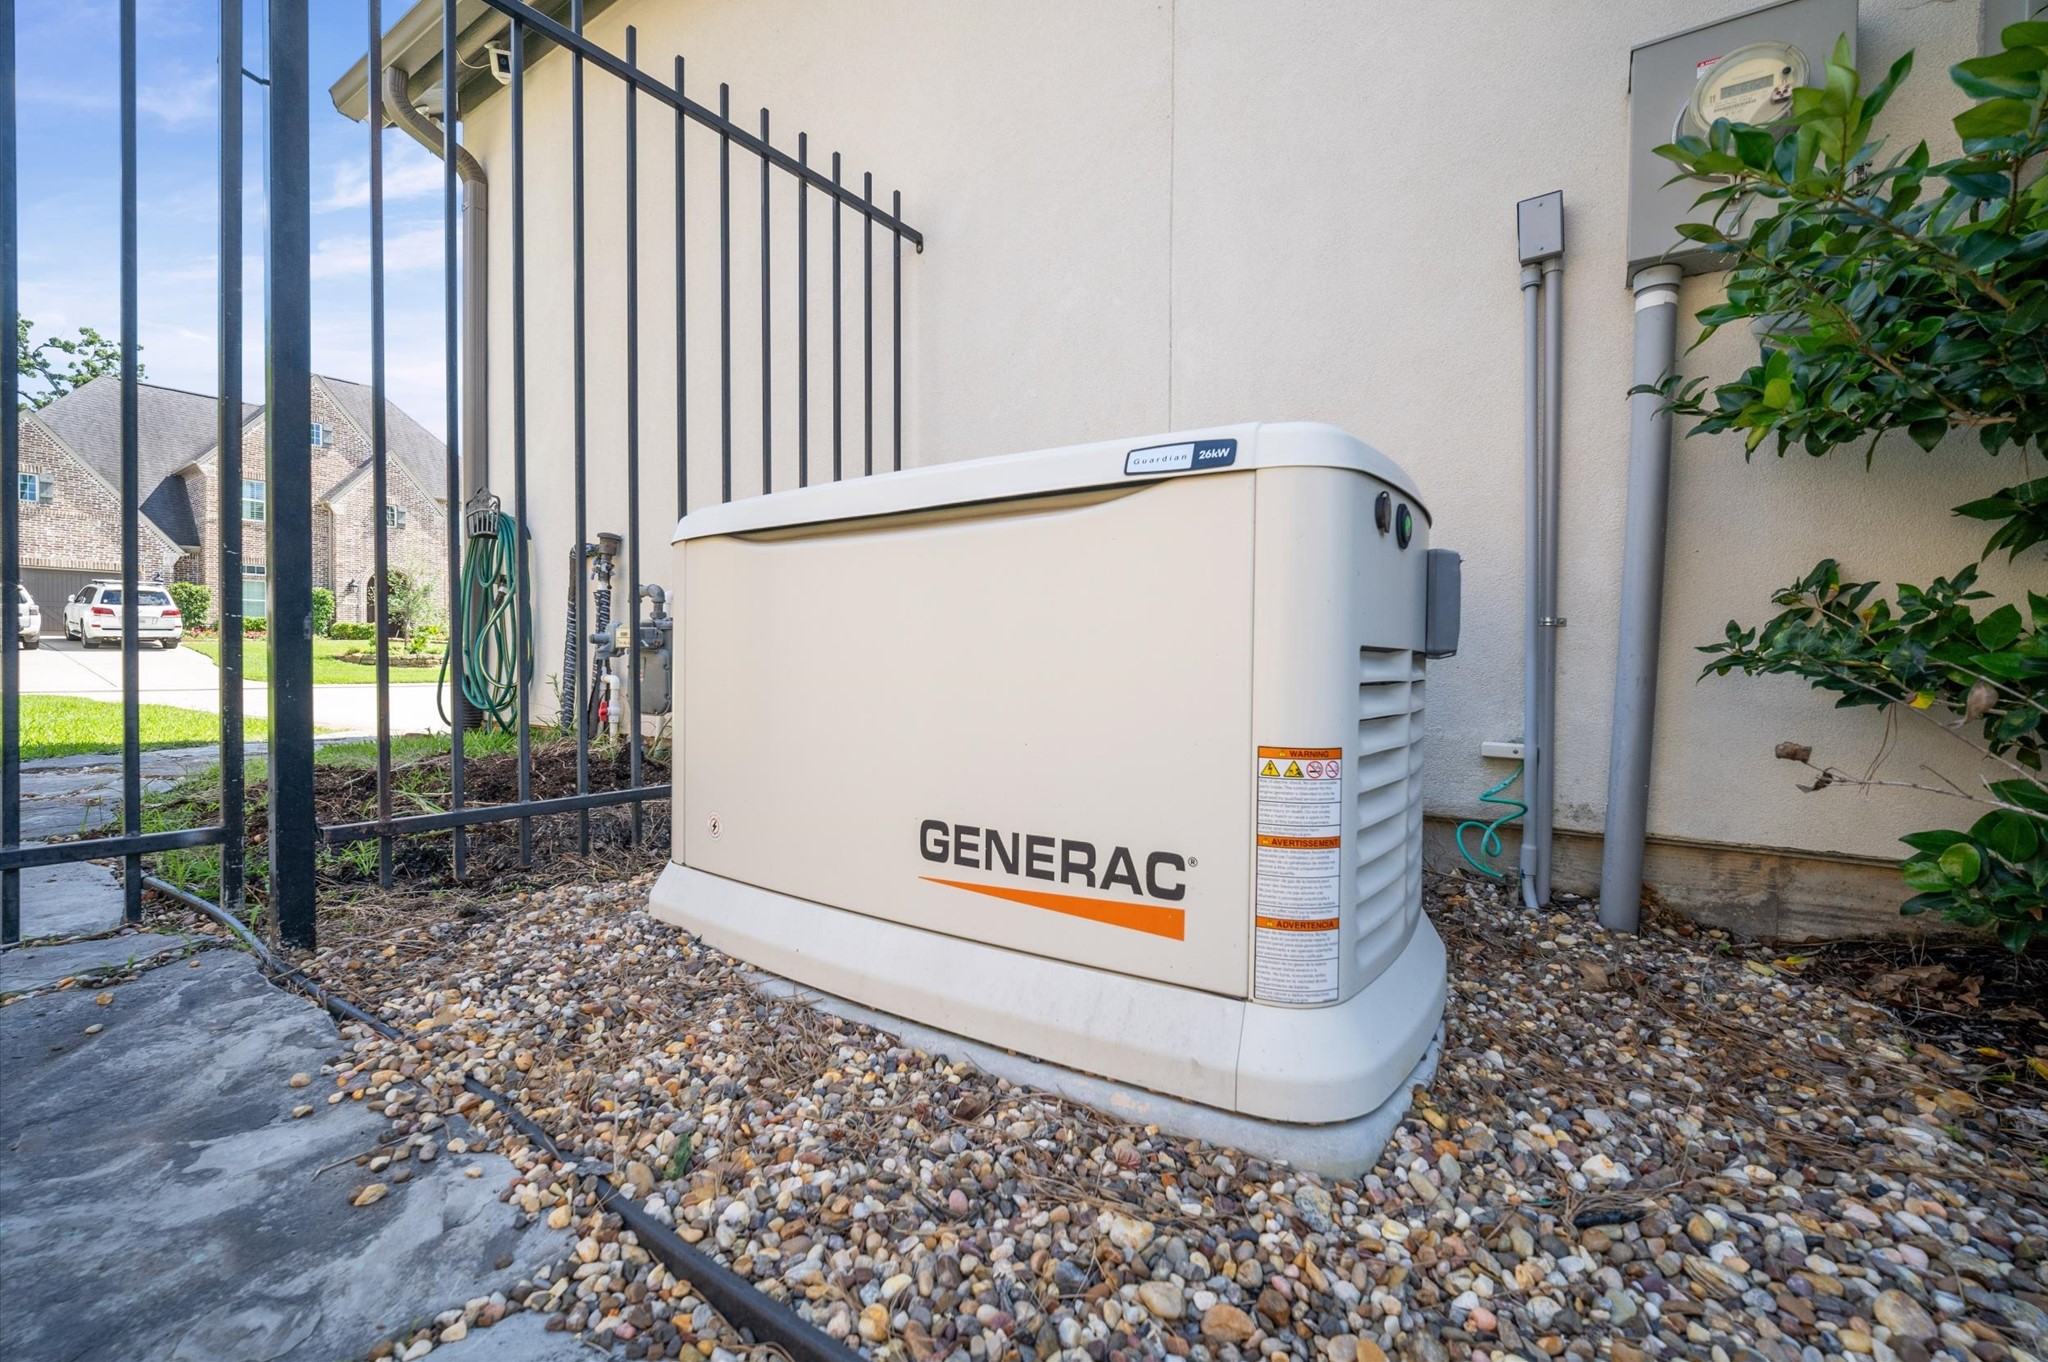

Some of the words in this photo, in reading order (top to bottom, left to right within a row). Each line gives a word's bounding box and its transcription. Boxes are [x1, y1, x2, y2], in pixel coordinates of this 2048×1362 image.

[1133, 454, 1188, 465] Guardian
[1198, 447, 1231, 460] 26kW
[1289, 750, 1329, 758] WARNING
[1271, 838, 1338, 848] AVERTISSEMENT
[919, 819, 1186, 901] GENERAC
[1276, 920, 1334, 929] ADVERTENCIA
